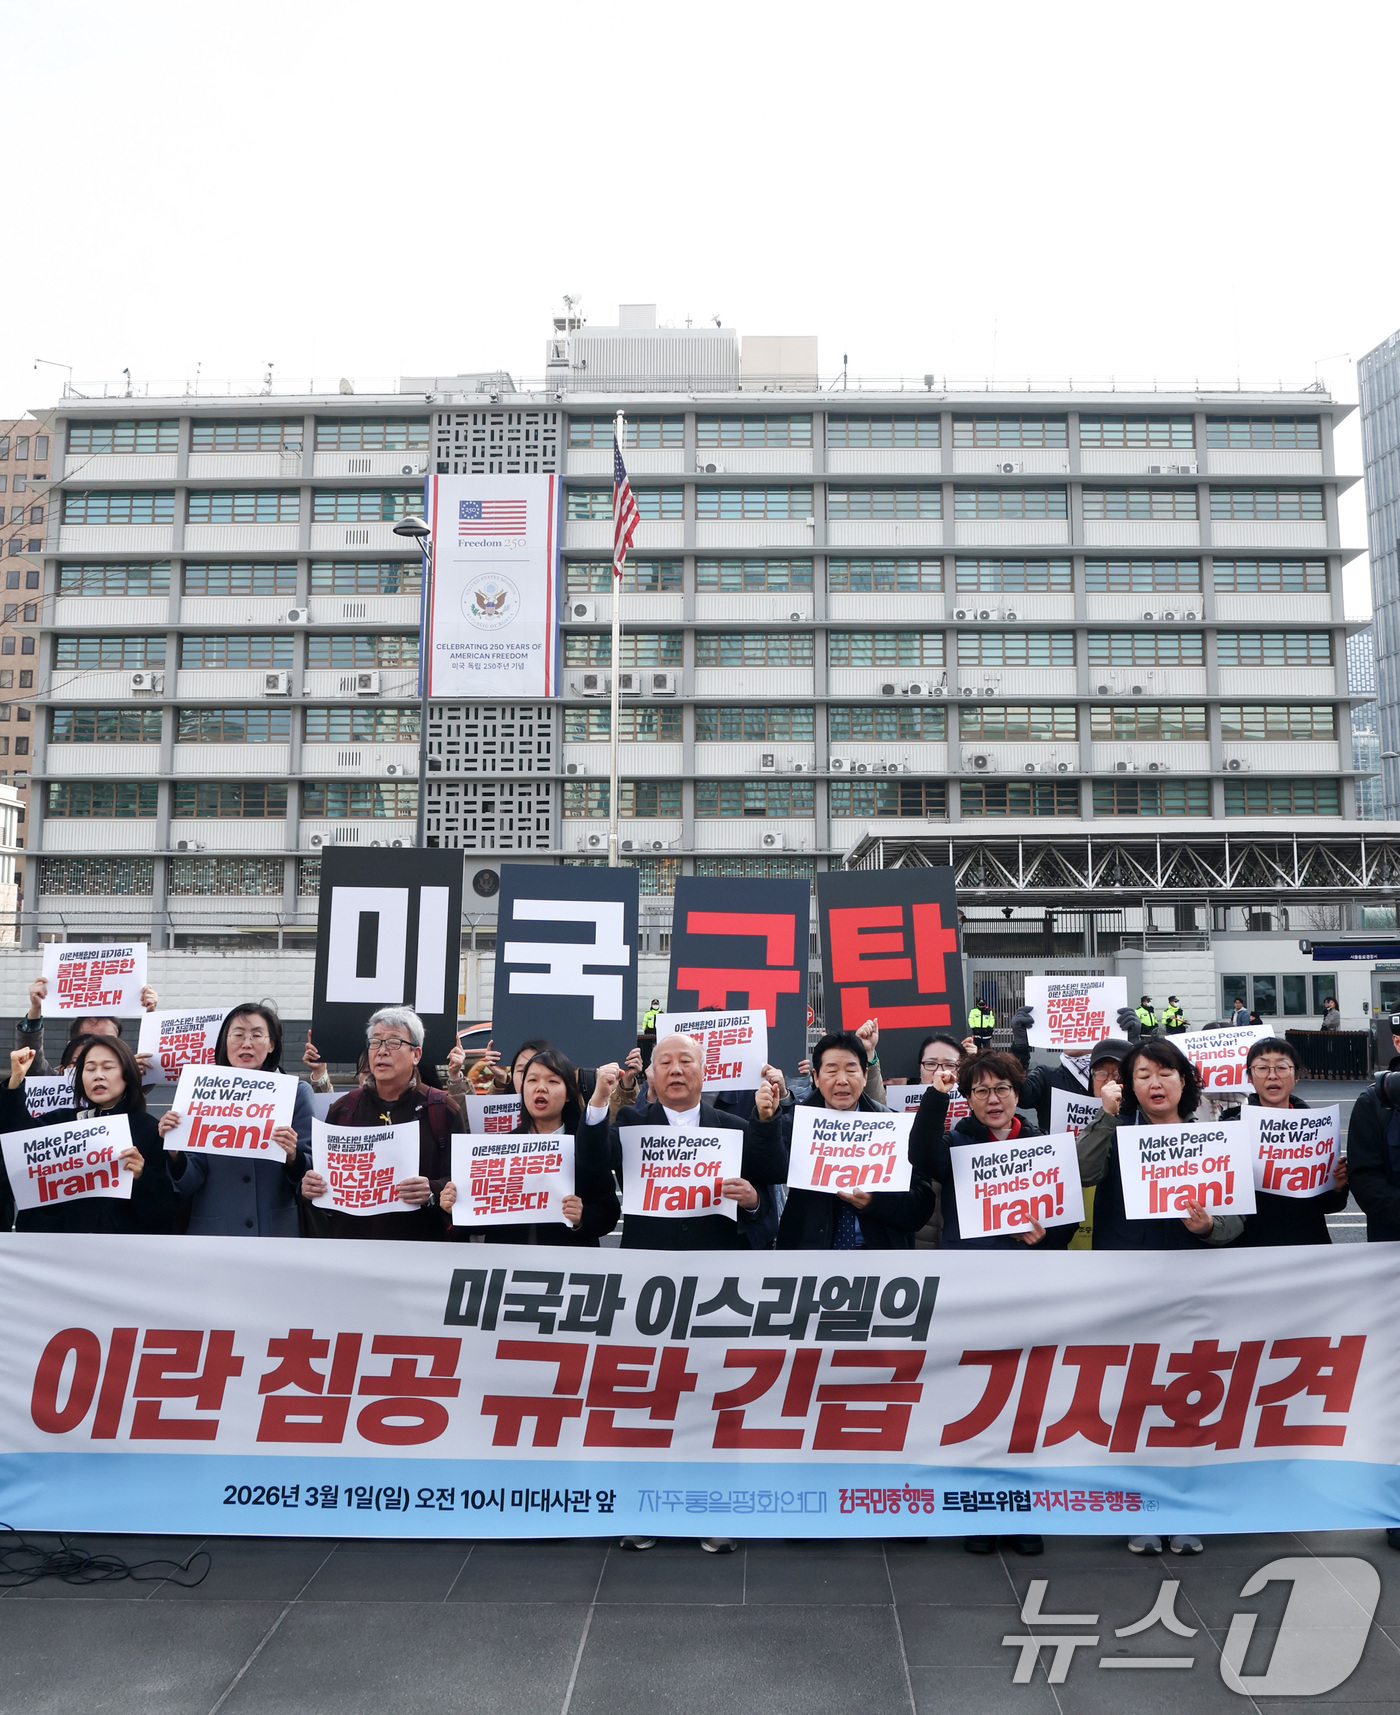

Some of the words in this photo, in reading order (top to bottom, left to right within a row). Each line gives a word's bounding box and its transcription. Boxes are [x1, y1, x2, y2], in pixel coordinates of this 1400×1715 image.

[458, 539, 502, 547] Freedom
[504, 538, 527, 550] 250
[451, 662, 465, 670] 미국
[467, 662, 481, 670] 독립
[483, 662, 510, 670] 250주년
[511, 662, 525, 670] 기념
[100, 948, 133, 959] 파기하고
[326, 885, 449, 1014] 미
[57, 962, 87, 978] 불법
[90, 958, 135, 976] 침공한
[503, 898, 630, 1021] 국
[829, 903, 957, 1031] 탄
[676, 911, 800, 1028] 규
[57, 977, 102, 993] 미국을
[59, 990, 123, 1009] 규탄한다!
[1047, 997, 1090, 1014] 전쟁광
[717, 1016, 750, 1028] 파기하고
[1049, 1011, 1105, 1028] 이스라엘
[161, 1026, 174, 1035] 이란
[708, 1027, 753, 1047] 침공한
[1050, 1026, 1110, 1044] 규탄한다!
[1184, 1035, 1217, 1044] Make
[1218, 1030, 1257, 1039] Peace,
[159, 1032, 206, 1053] 전쟁광
[1210, 1038, 1238, 1048] War!
[1188, 1048, 1236, 1060] Hands
[27, 1085, 55, 1097] Make
[193, 1076, 230, 1088] Make
[232, 1077, 277, 1093] Peace,
[27, 1098, 44, 1108] Not
[191, 1088, 217, 1100] Not
[219, 1089, 252, 1101] War!
[187, 1101, 243, 1117] Hands
[246, 1103, 275, 1118] Off
[1067, 1102, 1099, 1115] Make
[484, 1115, 513, 1133] 불법
[813, 1118, 850, 1130] Make
[853, 1120, 896, 1131] Peace,
[1067, 1113, 1090, 1124] Not
[1260, 1119, 1298, 1131] Make
[1300, 1115, 1333, 1129] Peace,
[23, 1136, 61, 1154] Make
[64, 1125, 110, 1143] Peace,
[187, 1116, 275, 1150] Iran!
[640, 1136, 676, 1149] Make
[677, 1135, 722, 1150] Peace,
[812, 1129, 837, 1141] Not
[840, 1131, 873, 1142] War!
[1139, 1136, 1178, 1150] Make
[1180, 1130, 1228, 1144] Peace,
[1260, 1132, 1285, 1143] Not
[1288, 1129, 1318, 1143] War!
[26, 1150, 51, 1165] Not
[53, 1140, 87, 1158] War!
[327, 1143, 341, 1152] 이란
[522, 1141, 560, 1153] 파기하고
[642, 1149, 664, 1161] Not
[666, 1148, 697, 1161] War!
[809, 1141, 865, 1157] Hands
[868, 1141, 896, 1156] Off
[971, 1153, 1008, 1169] Make
[1010, 1144, 1056, 1161] Peace,
[1141, 1150, 1165, 1163] Not
[1169, 1144, 1203, 1159] War!
[1258, 1144, 1313, 1160] Hands
[1315, 1137, 1334, 1156] Off
[28, 1156, 84, 1179] Hands
[86, 1146, 113, 1165] Off
[327, 1152, 376, 1171] 전쟁광
[470, 1158, 506, 1178] 불법
[509, 1153, 563, 1175] 침공한
[640, 1162, 691, 1178] Hands
[694, 1161, 722, 1177] Off
[974, 1168, 997, 1182] Not
[1000, 1159, 1032, 1176] War!
[1141, 1160, 1198, 1181] Hands
[1201, 1155, 1231, 1173] Off
[330, 1166, 395, 1189] 이스라엘
[810, 1155, 897, 1188] Iran!
[1262, 1152, 1335, 1191] Iran!
[37, 1160, 119, 1203] Iran!
[471, 1176, 524, 1196] 미국을
[975, 1176, 1030, 1199] Hands
[1032, 1166, 1060, 1187] Off
[642, 1177, 724, 1211] Iran!
[1149, 1171, 1235, 1214] Iran!
[473, 1191, 549, 1216] 규탄한다!
[982, 1182, 1064, 1232] Iran!
[443, 1268, 626, 1337] 미국과
[635, 1275, 940, 1341] 이스라엘의
[30, 1326, 245, 1441] 이란
[255, 1328, 463, 1446] 침공
[480, 1338, 698, 1449] 규탄
[711, 1347, 927, 1451] 긴급
[939, 1334, 1367, 1453] 기자회견
[223, 1484, 300, 1508] 2026년
[304, 1485, 339, 1509] 3월
[344, 1485, 410, 1512] 1일(일)
[414, 1487, 455, 1511] 오전
[460, 1488, 505, 1512] 10시
[510, 1488, 592, 1513] 미대사관
[595, 1489, 617, 1513] 앞
[638, 1489, 827, 1513] 자주통일평화연대
[838, 1483, 935, 1514] 전국민중행동
